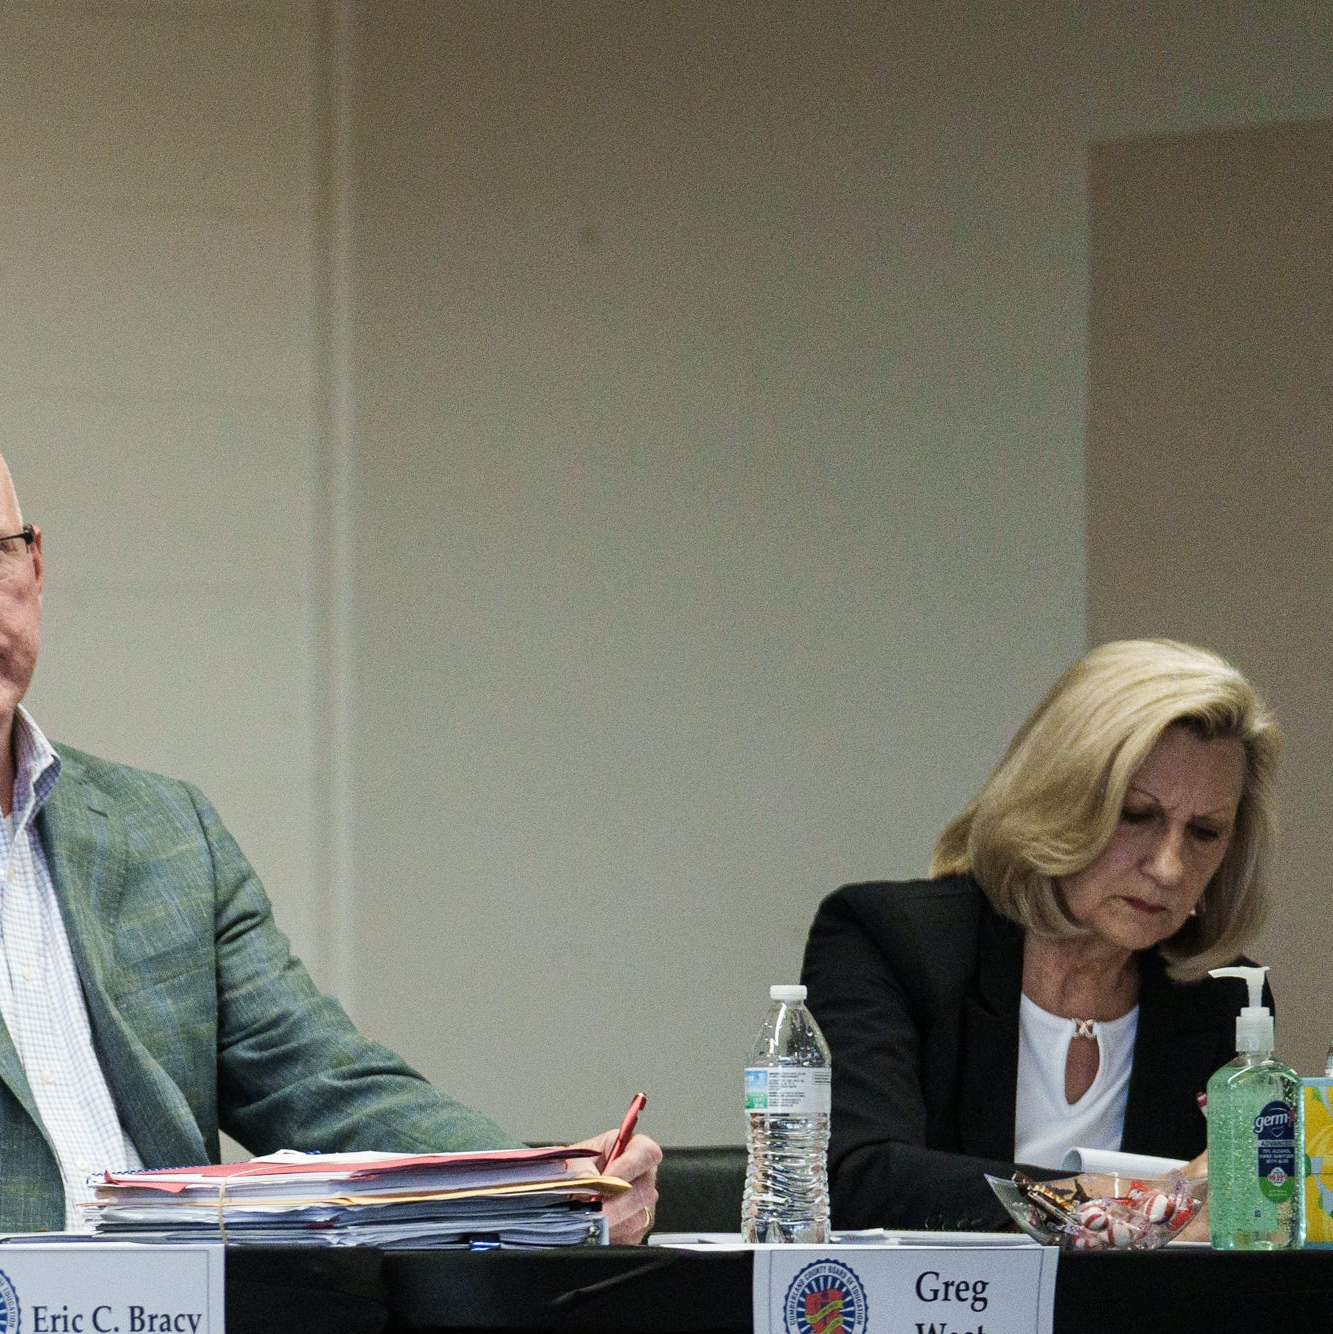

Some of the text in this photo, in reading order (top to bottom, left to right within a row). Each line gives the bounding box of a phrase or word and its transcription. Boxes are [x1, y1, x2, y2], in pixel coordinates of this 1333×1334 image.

[915, 1271, 989, 1312] Greg
[32, 1306, 84, 1333] Eric
[92, 1306, 119, 1333] C.
